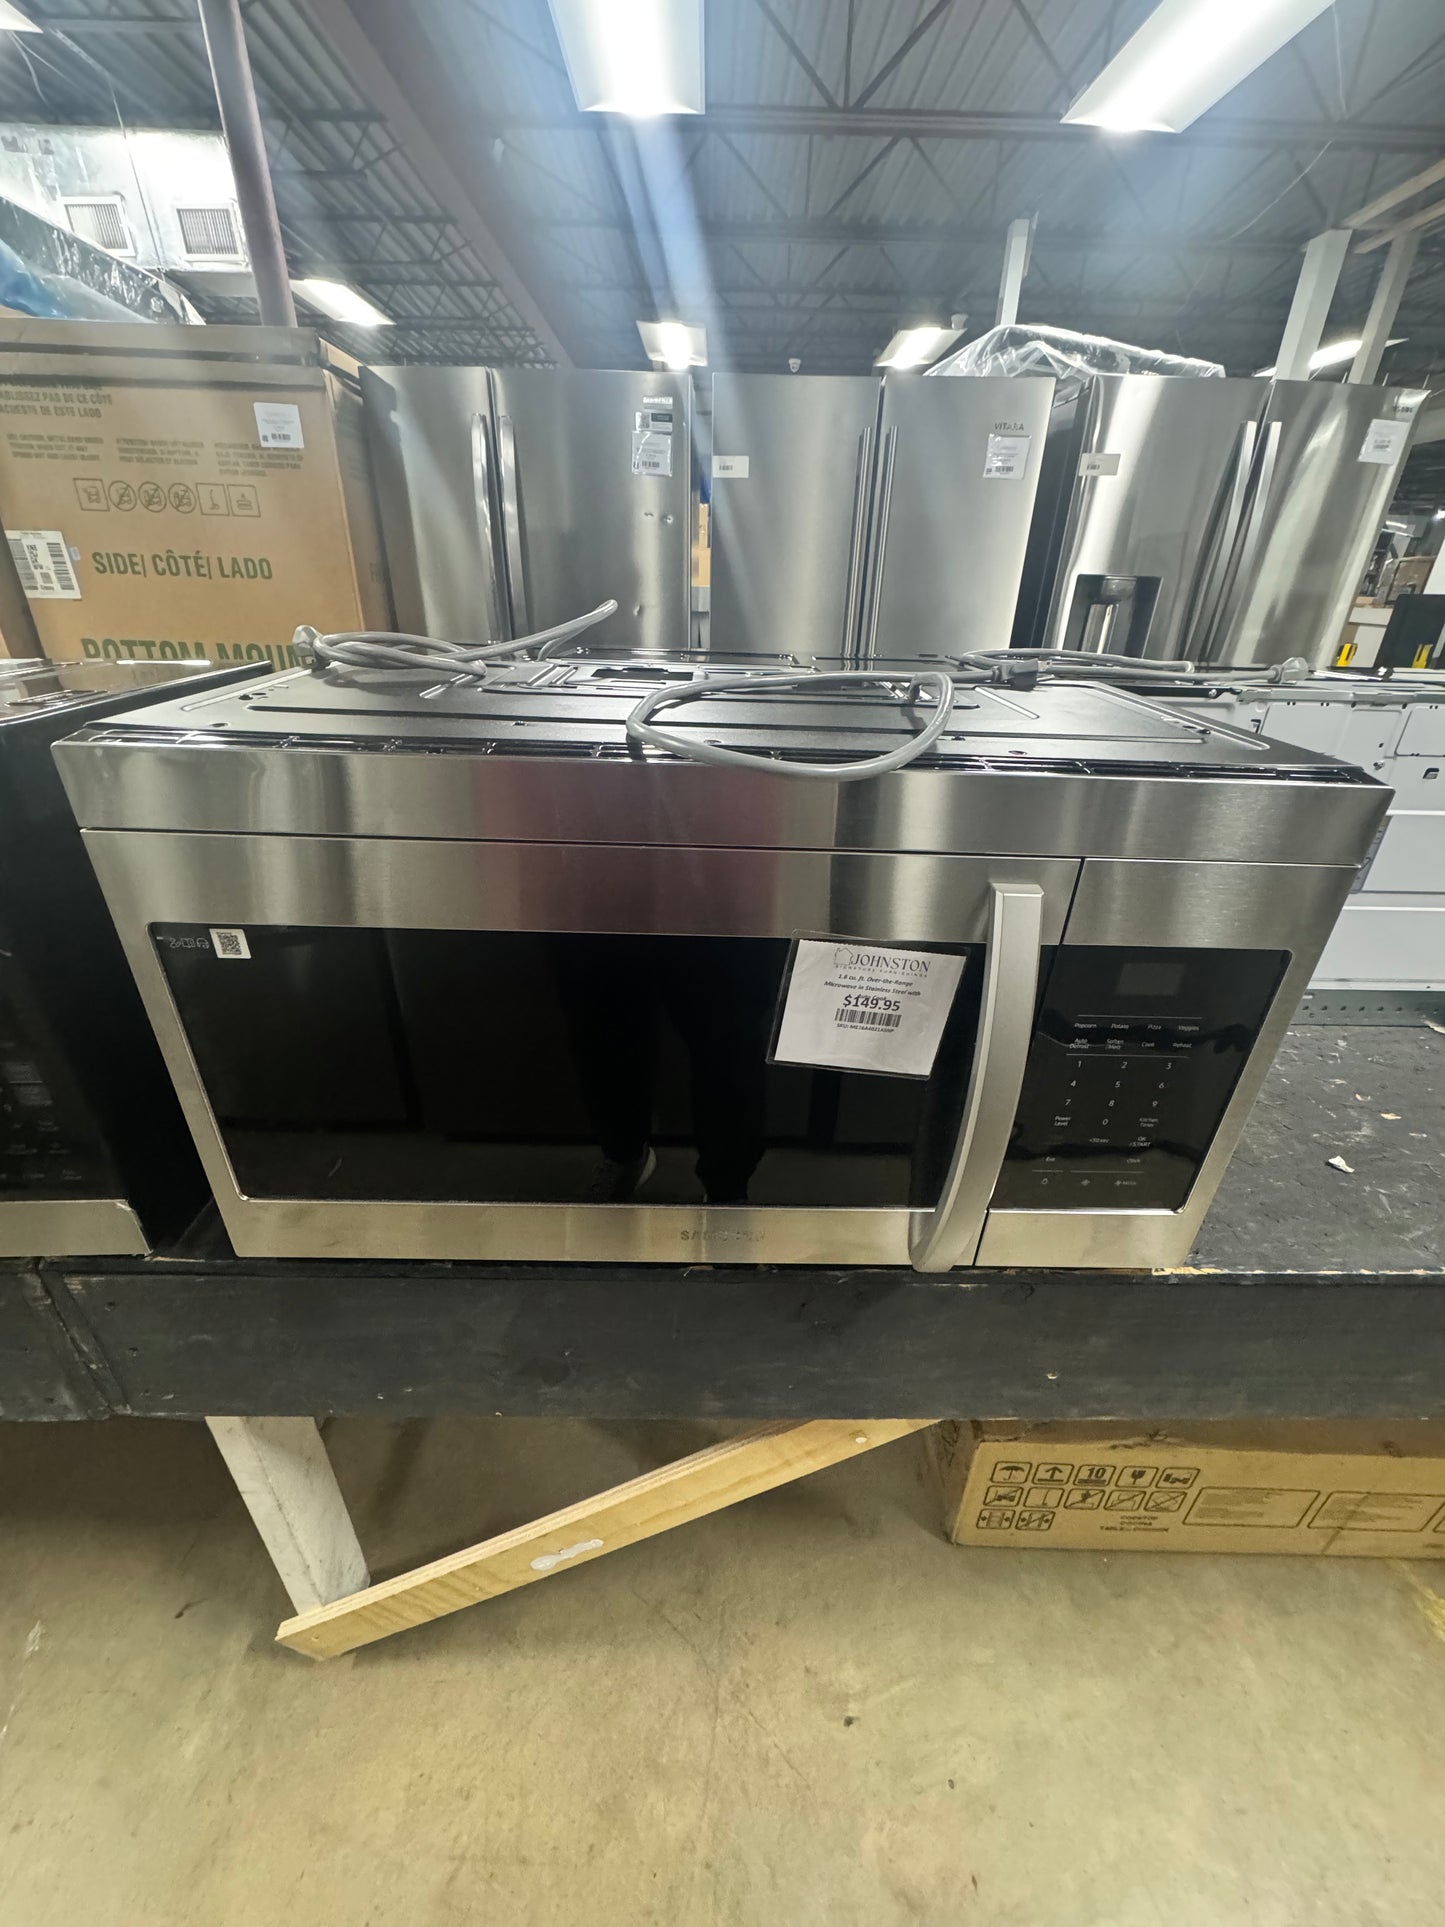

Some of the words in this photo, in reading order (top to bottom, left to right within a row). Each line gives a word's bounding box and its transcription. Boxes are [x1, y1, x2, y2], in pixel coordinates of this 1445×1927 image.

[78, 407, 102, 418] LADO
[217, 556, 273, 580] LADO
[853, 953, 931, 972] JOHNSTON
[843, 994, 901, 1012] $149.95
[1087, 1467, 1106, 1479] 10
